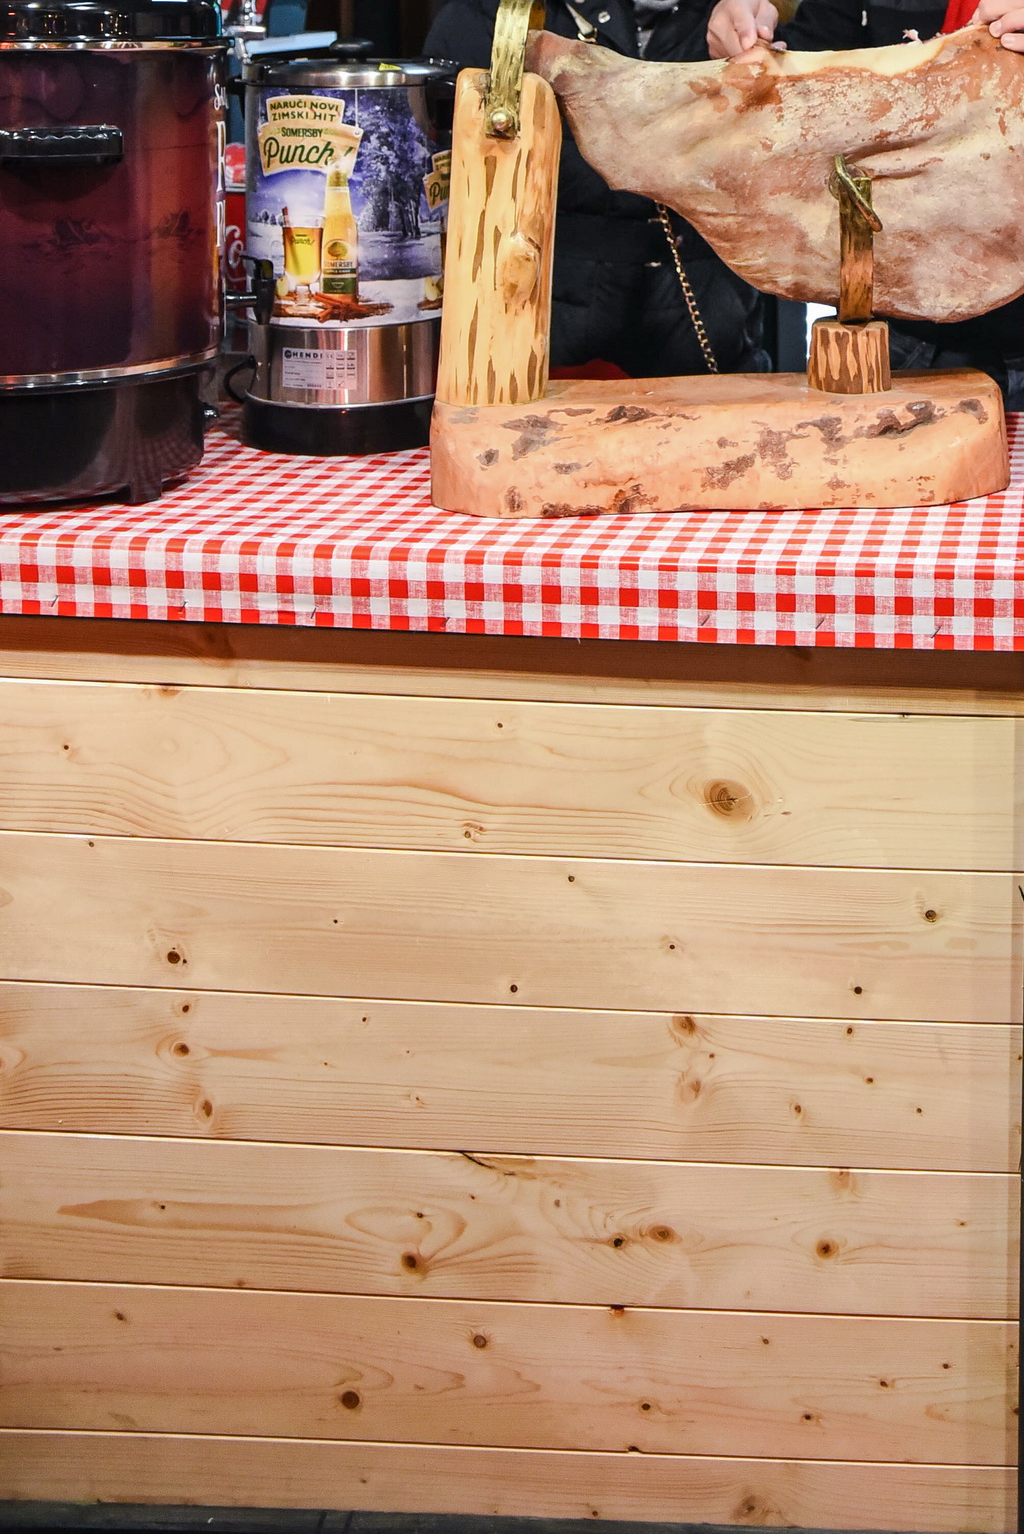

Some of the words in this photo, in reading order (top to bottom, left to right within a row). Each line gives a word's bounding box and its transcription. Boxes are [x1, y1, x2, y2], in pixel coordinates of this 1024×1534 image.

[270, 99, 306, 111] NARUČI
[310, 102, 338, 111] NOVI
[272, 111, 308, 121] ZIMSKI
[314, 112, 336, 122] HIT
[281, 127, 323, 137] SOMERSBY
